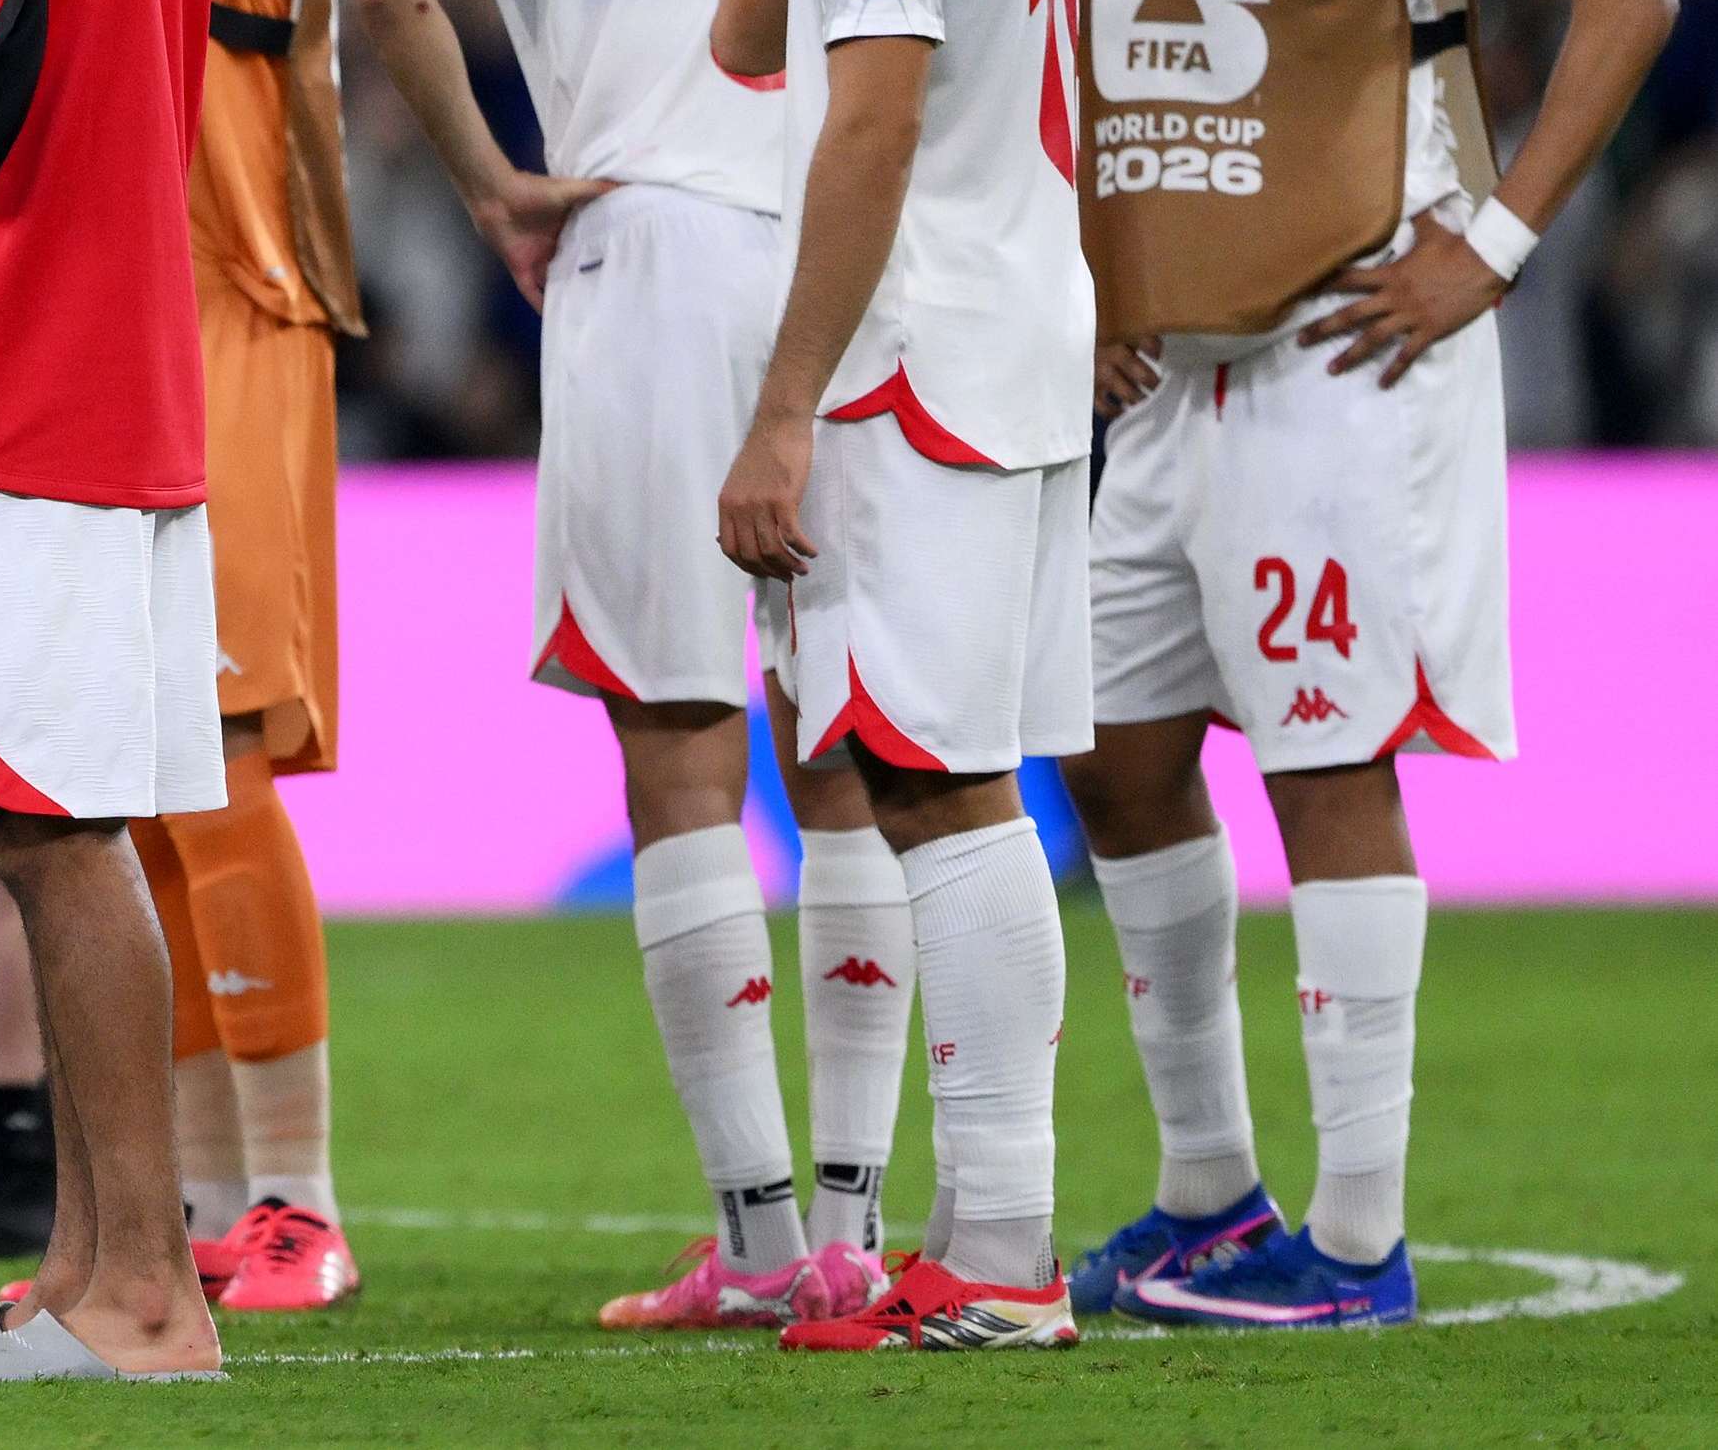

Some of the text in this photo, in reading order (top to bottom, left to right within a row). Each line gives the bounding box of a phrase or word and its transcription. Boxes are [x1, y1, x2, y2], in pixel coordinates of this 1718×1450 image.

[1127, 40, 1212, 73] FIFA
[1193, 115, 1266, 147] CUP
[1096, 147, 1265, 200] 2026
[1254, 556, 1359, 661] 24
